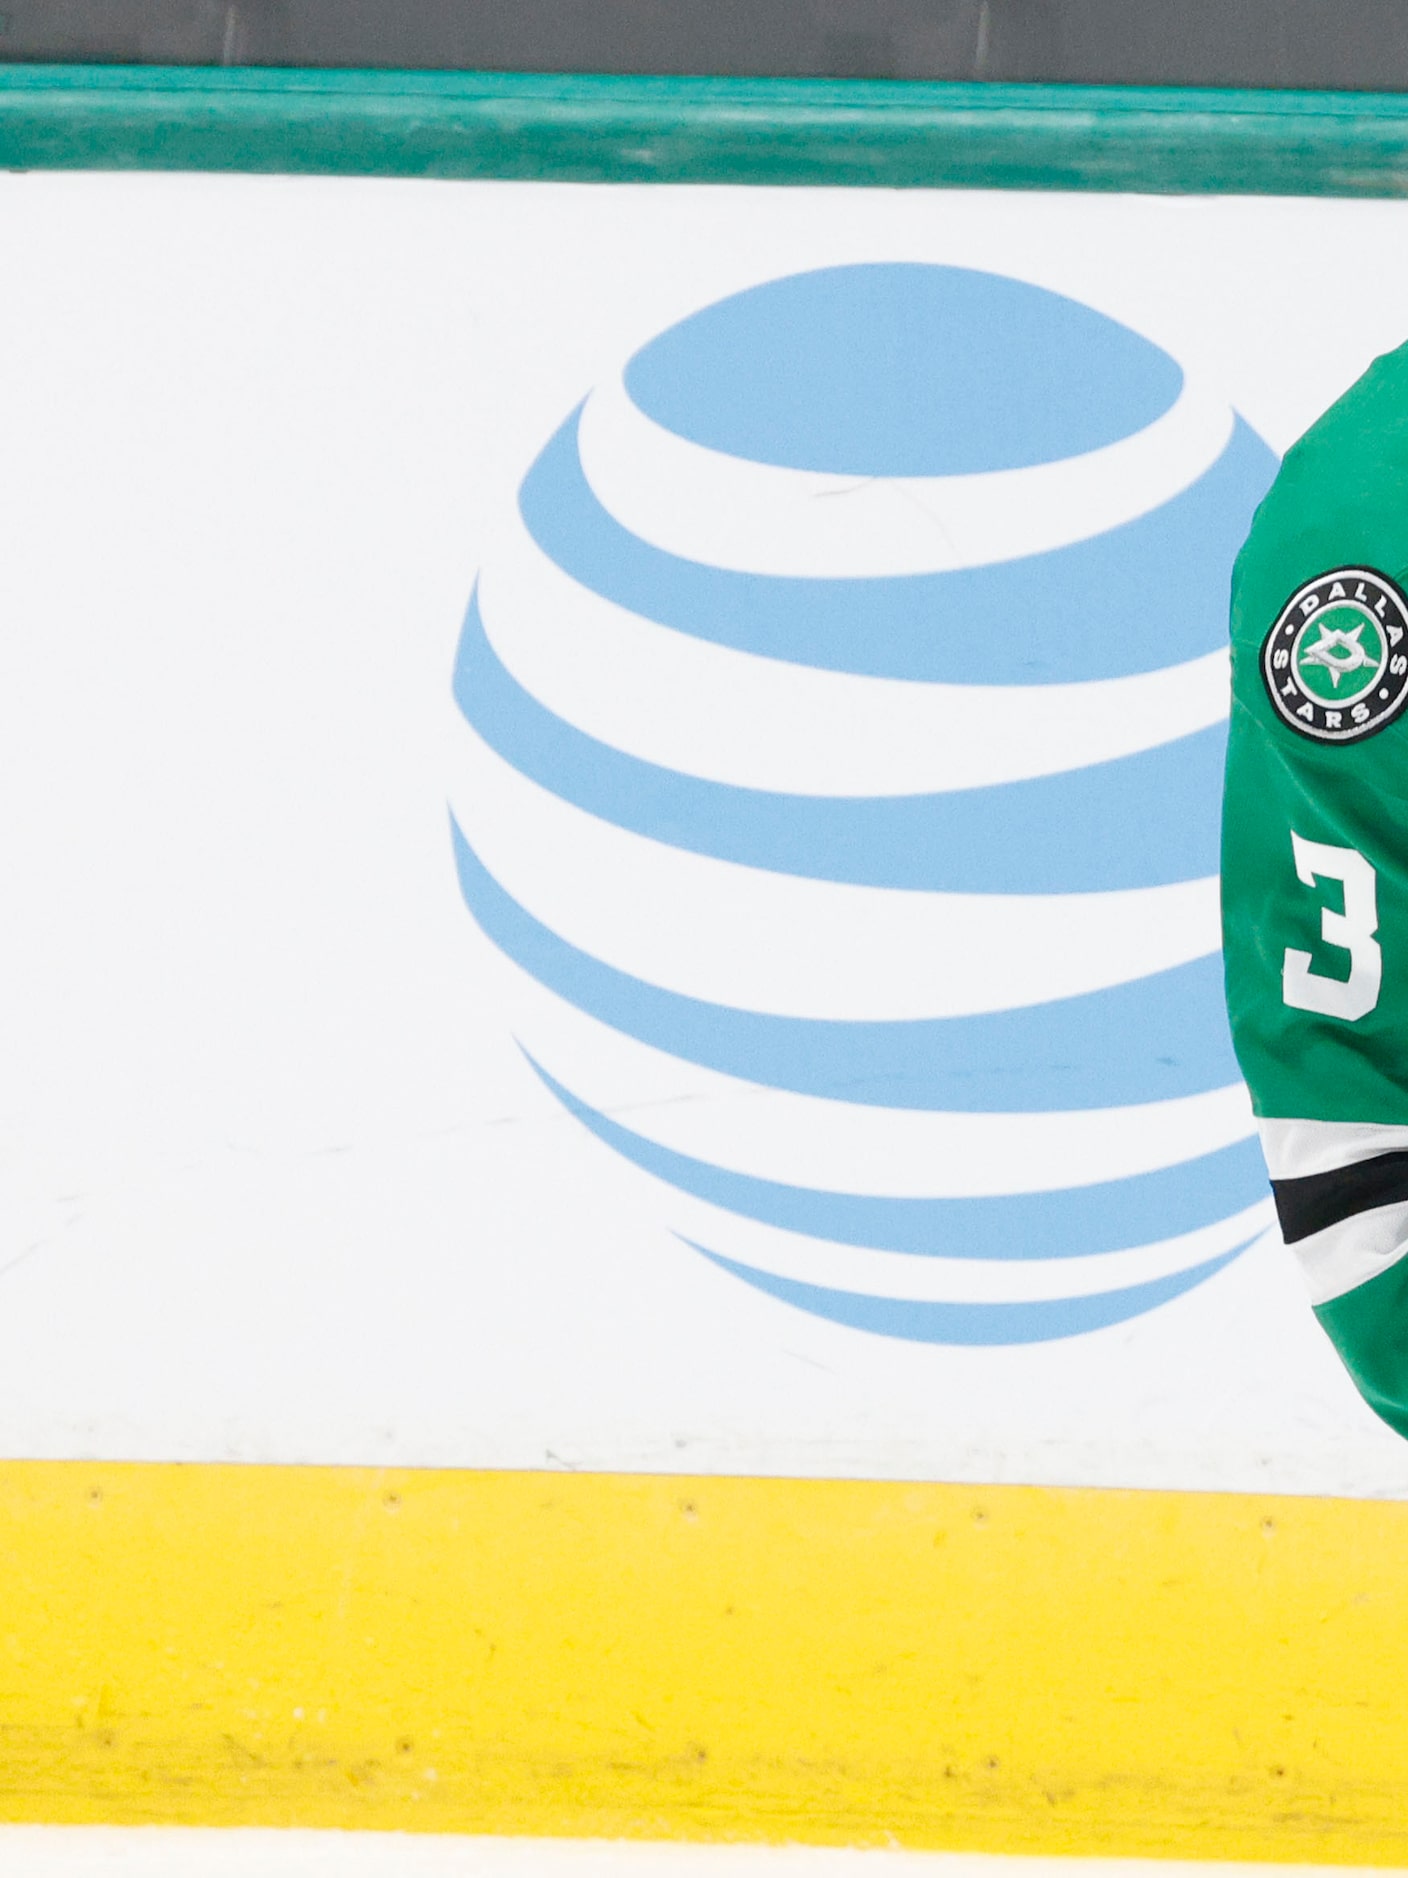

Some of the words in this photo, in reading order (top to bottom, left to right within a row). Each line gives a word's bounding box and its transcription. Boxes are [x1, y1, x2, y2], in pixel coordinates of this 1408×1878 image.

[1299, 582, 1408, 675] DALLAS
[1273, 649, 1370, 728] STARS
[1282, 829, 1383, 1022] 3
